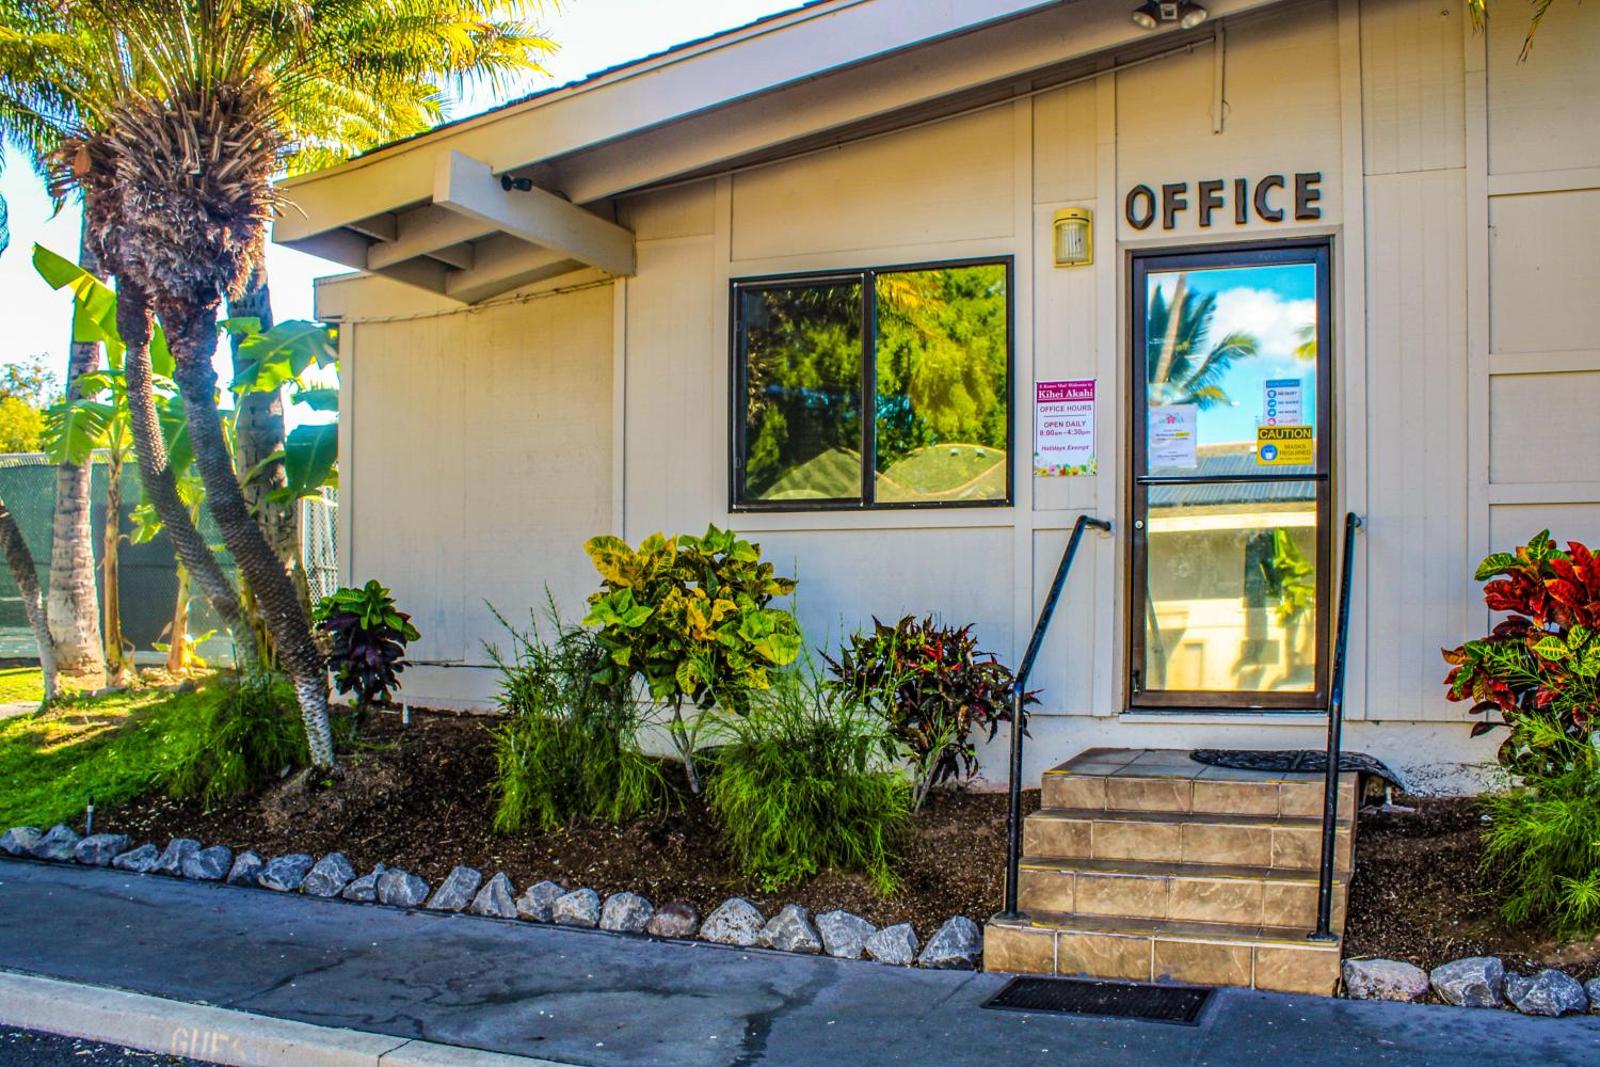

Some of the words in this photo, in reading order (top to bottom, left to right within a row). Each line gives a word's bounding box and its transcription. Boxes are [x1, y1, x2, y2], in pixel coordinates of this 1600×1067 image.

[1125, 172, 1321, 230] OFFICE
[1038, 390, 1063, 399] Kihei
[1066, 388, 1093, 398] Akahi
[1260, 429, 1311, 439] CAUTION
